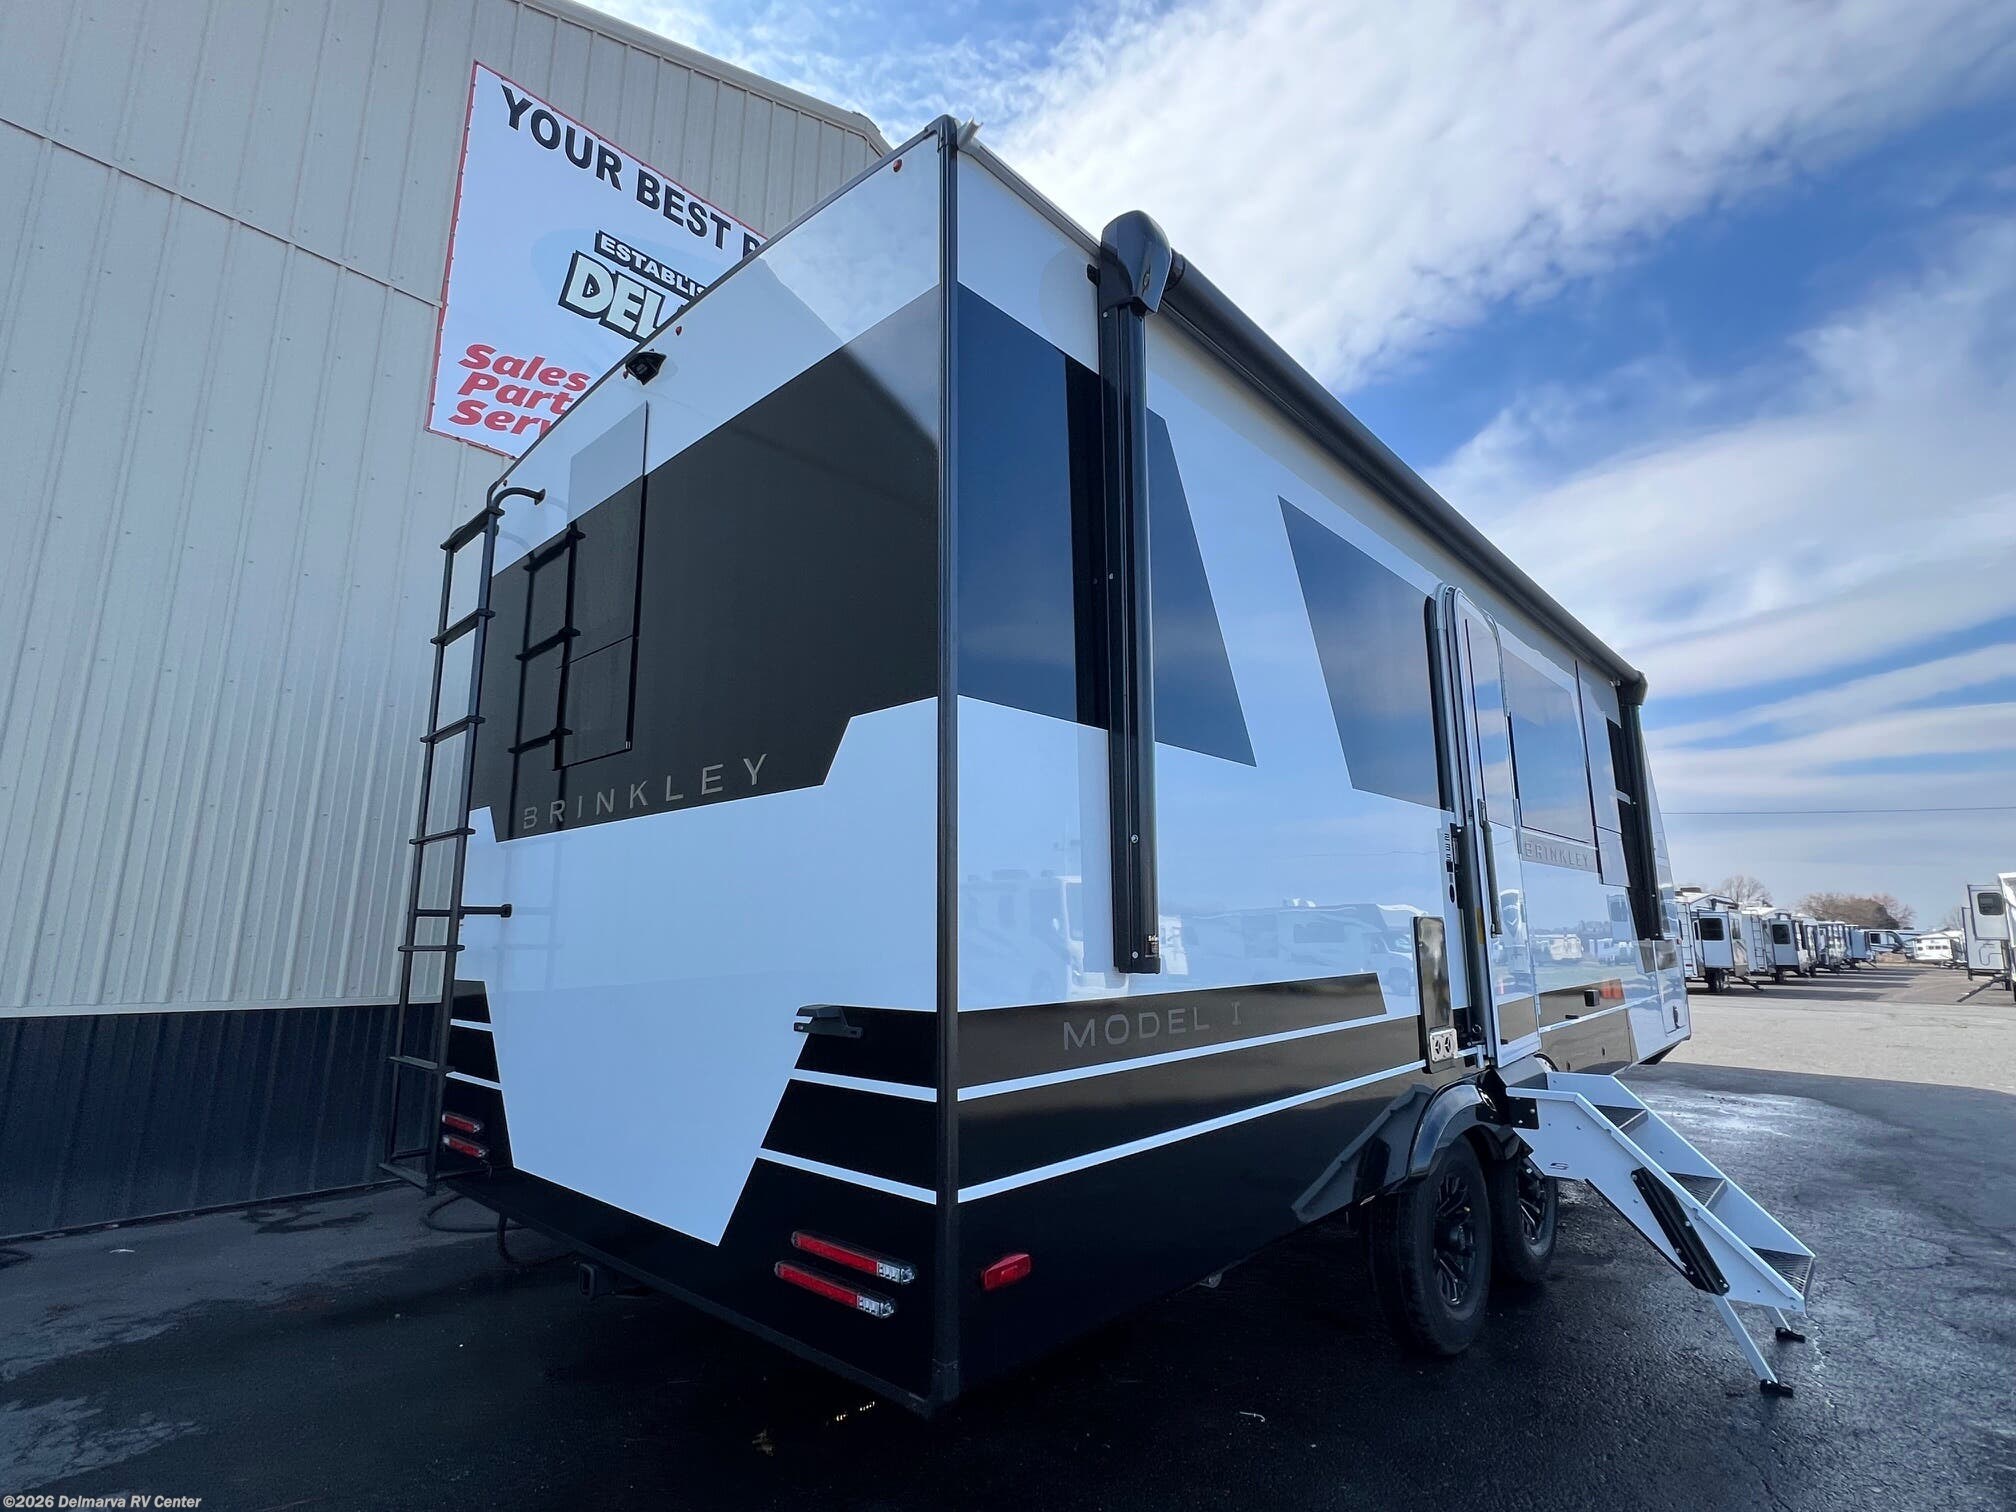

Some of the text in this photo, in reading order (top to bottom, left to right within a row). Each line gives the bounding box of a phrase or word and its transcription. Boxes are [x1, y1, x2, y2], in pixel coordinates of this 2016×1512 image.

[501, 84, 732, 250] YOUR BEST
[457, 344, 591, 392] Sales
[457, 371, 575, 415] Part
[523, 753, 767, 830] BRINKLEY
[1524, 840, 1589, 868] BRINKLEY
[1063, 1006, 1210, 1050] MODEL
